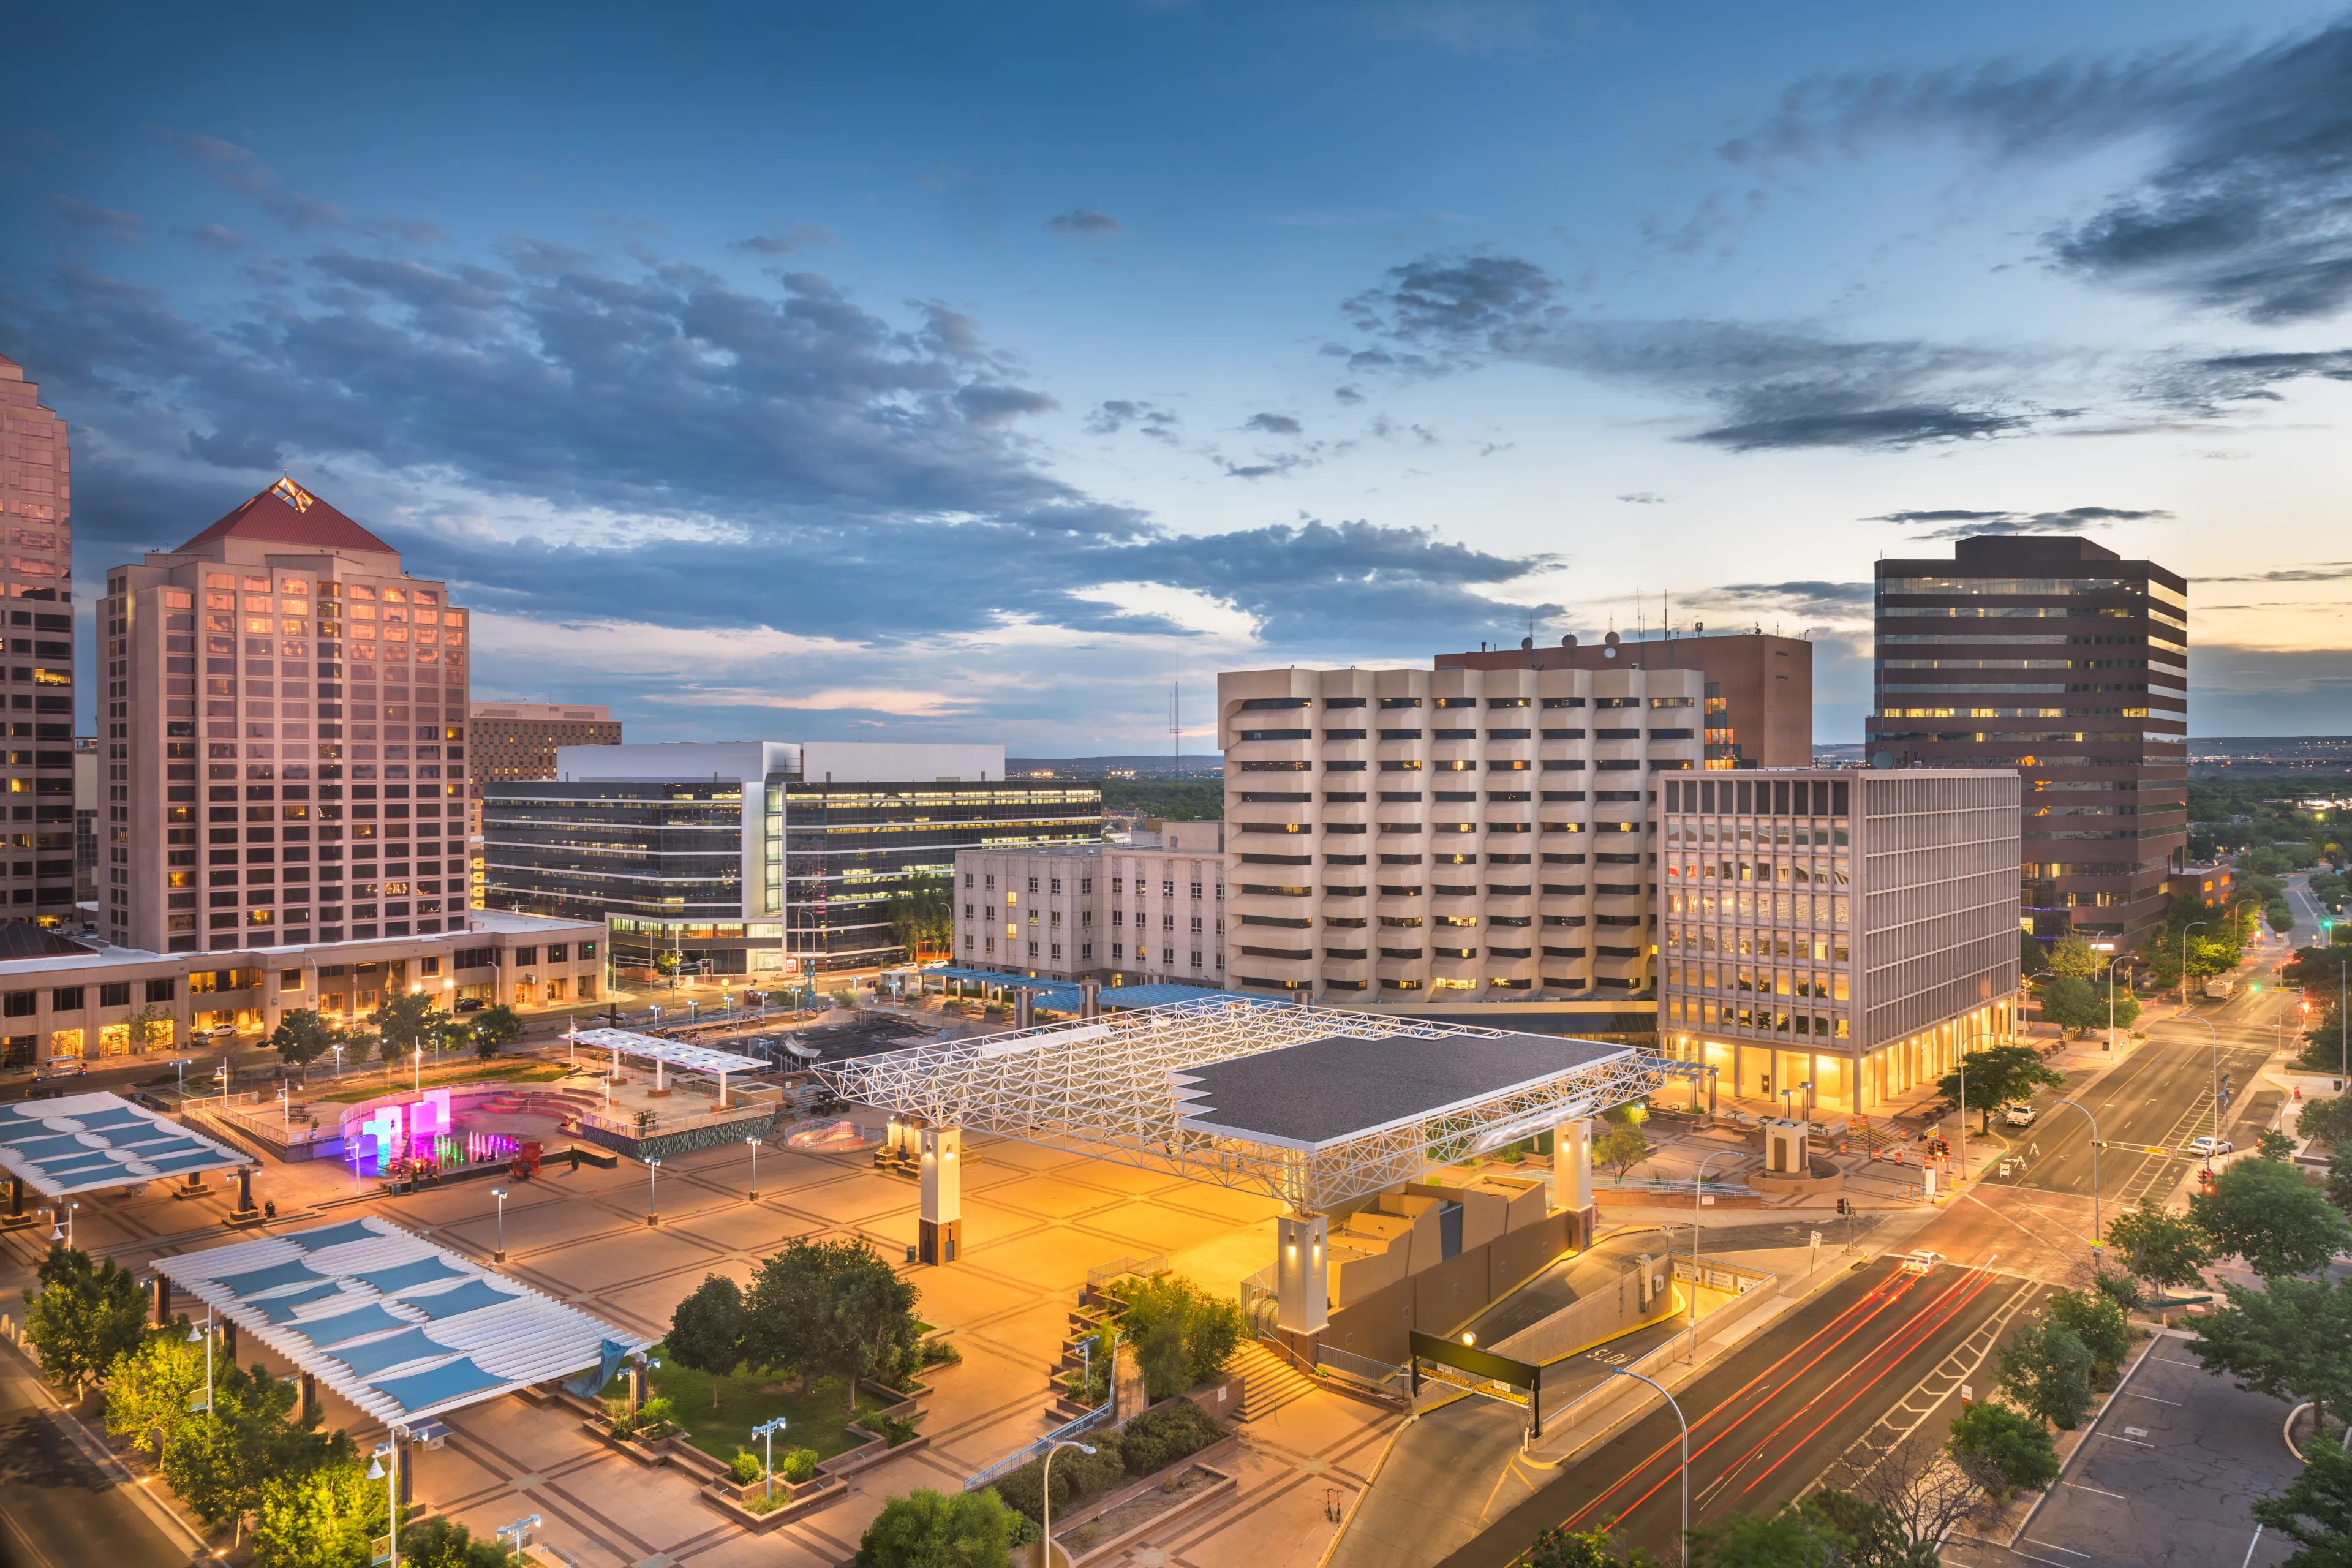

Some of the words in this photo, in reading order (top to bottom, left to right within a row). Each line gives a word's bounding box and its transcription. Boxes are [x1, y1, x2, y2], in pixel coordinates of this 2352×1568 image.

[1586, 1349, 1635, 1365] SLOW
[1444, 1374, 1466, 1385] VEHICLES
[1489, 1389, 1515, 1400] CLEARANCE
